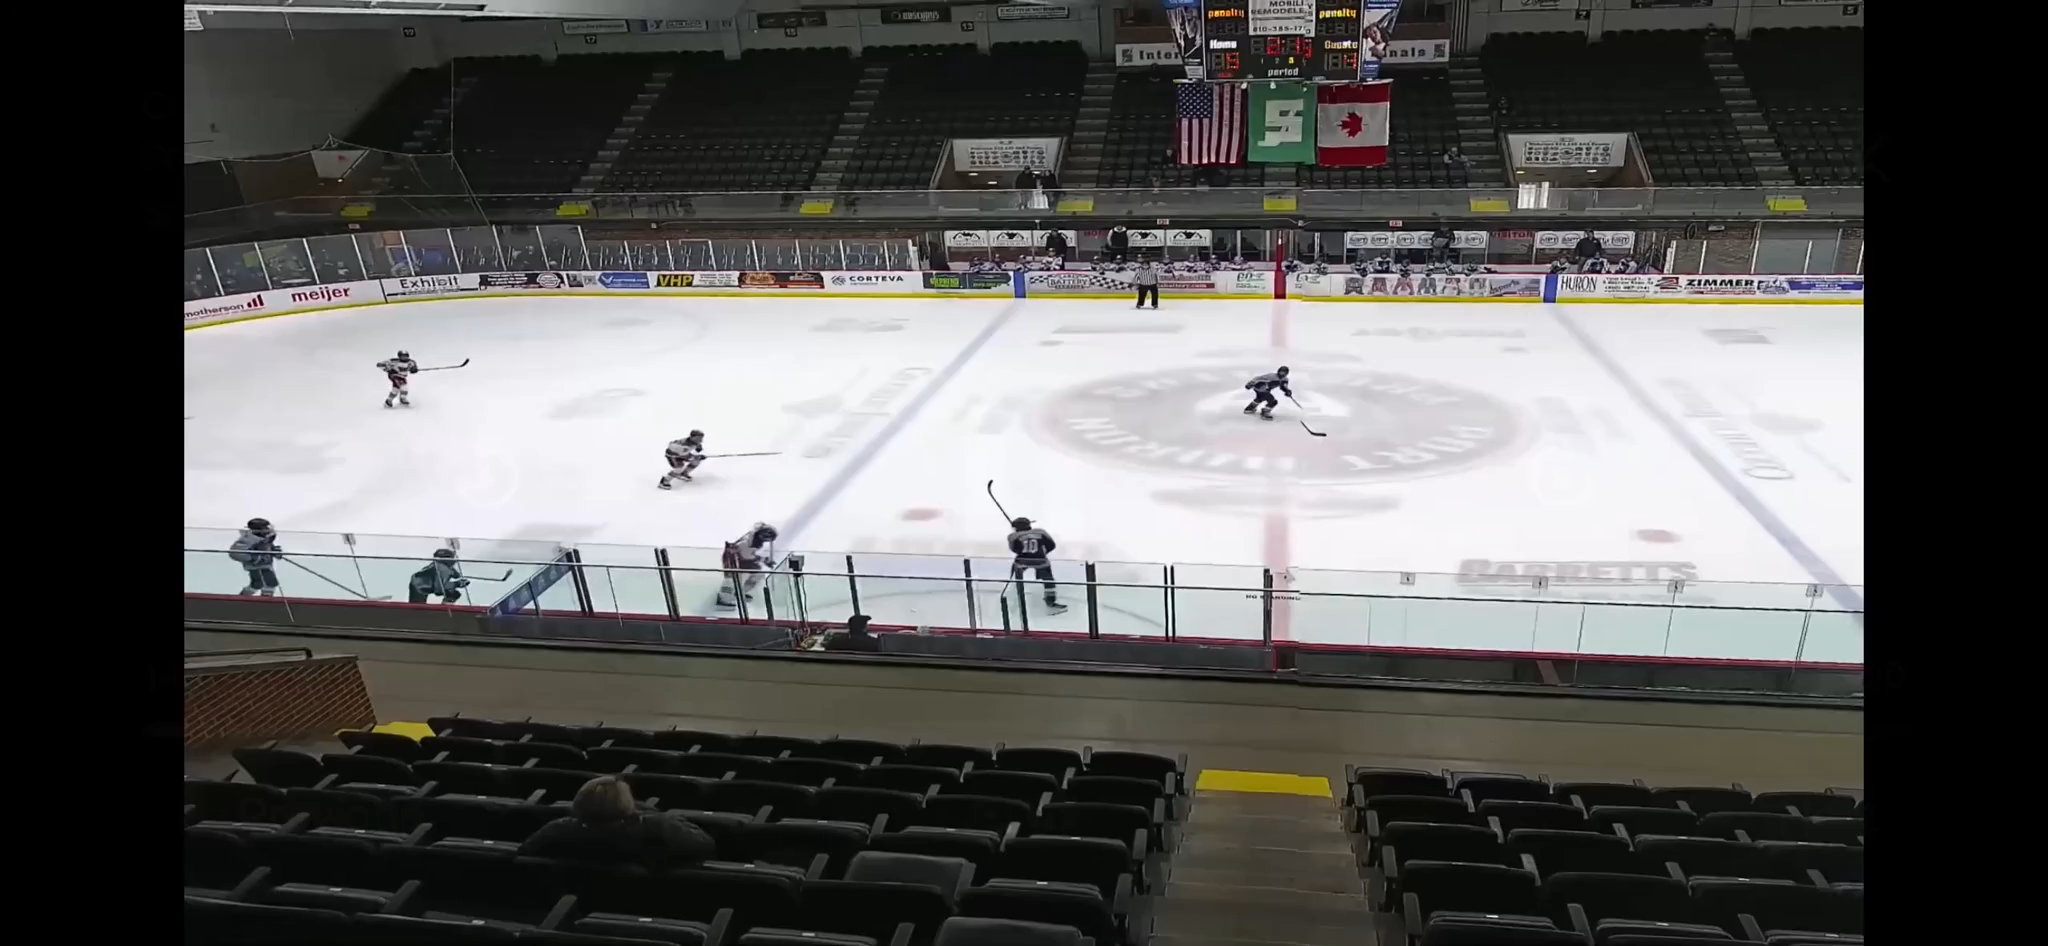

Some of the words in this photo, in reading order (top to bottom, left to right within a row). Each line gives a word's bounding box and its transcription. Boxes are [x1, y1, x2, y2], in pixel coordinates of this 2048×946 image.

[1269, 0, 1313, 10] MOBILIY
[1208, 8, 1244, 19] penalty
[1319, 8, 1356, 19] penalty
[1209, 39, 1237, 49] Home
[1140, 50, 1180, 60] Inter
[1389, 47, 1426, 58] nals
[1267, 67, 1299, 77] period
[400, 276, 459, 289] Exhibit
[658, 275, 694, 287] VHP
[849, 275, 905, 283] CORTEVA
[1050, 278, 1088, 286] BATTERY
[1560, 275, 1597, 292] HURON
[1685, 278, 1754, 287] ZIMMER
[291, 287, 351, 302] meijer
[184, 303, 245, 319] motherson
[1022, 539, 1039, 553] 10
